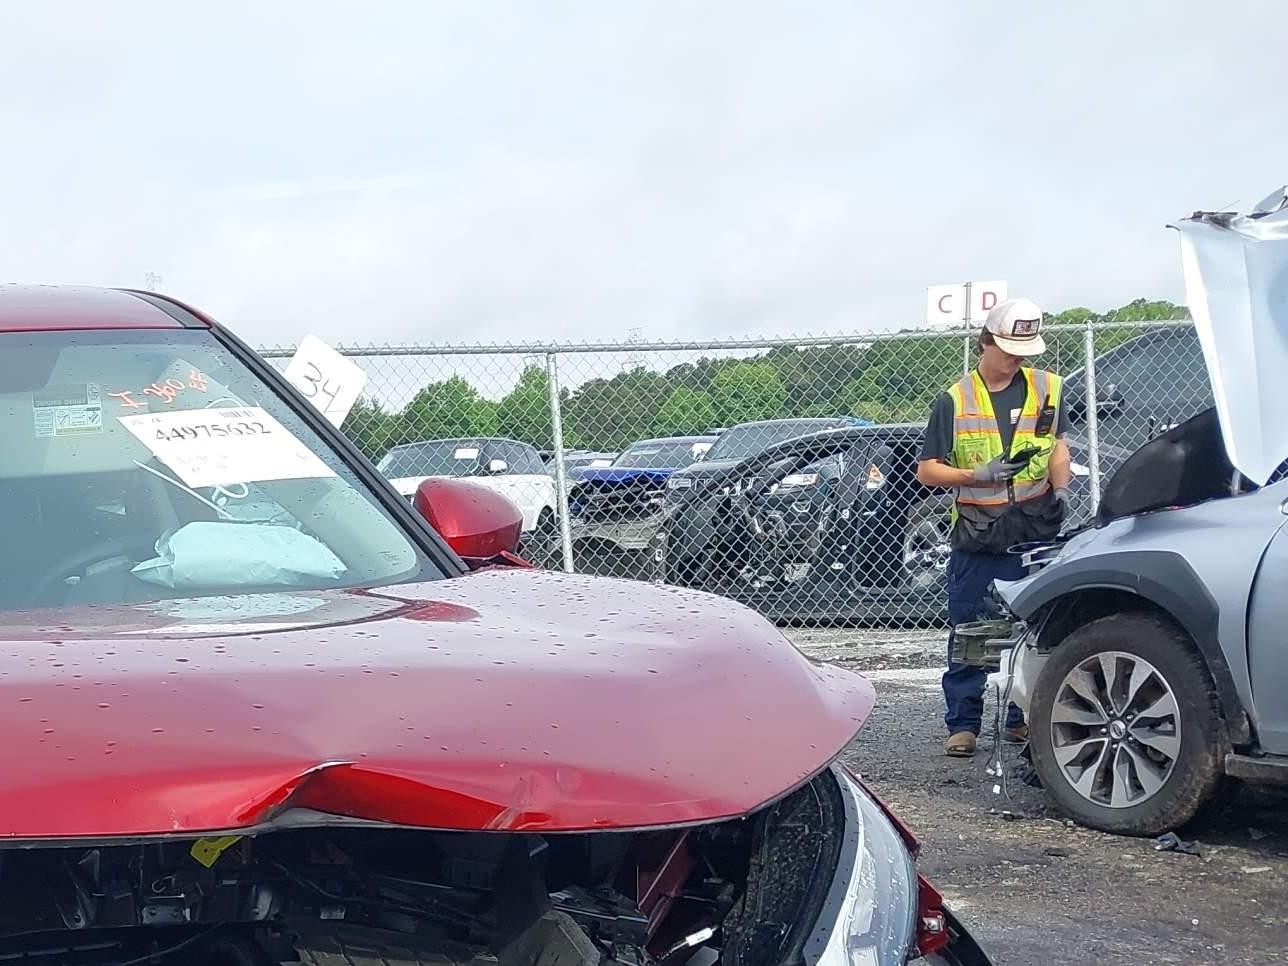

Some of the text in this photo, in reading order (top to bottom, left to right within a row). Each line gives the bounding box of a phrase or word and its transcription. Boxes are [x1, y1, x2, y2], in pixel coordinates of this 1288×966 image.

[938, 294, 953, 313] C
[982, 292, 998, 311] D
[291, 361, 341, 415] 34
[155, 422, 272, 441] 44975632
